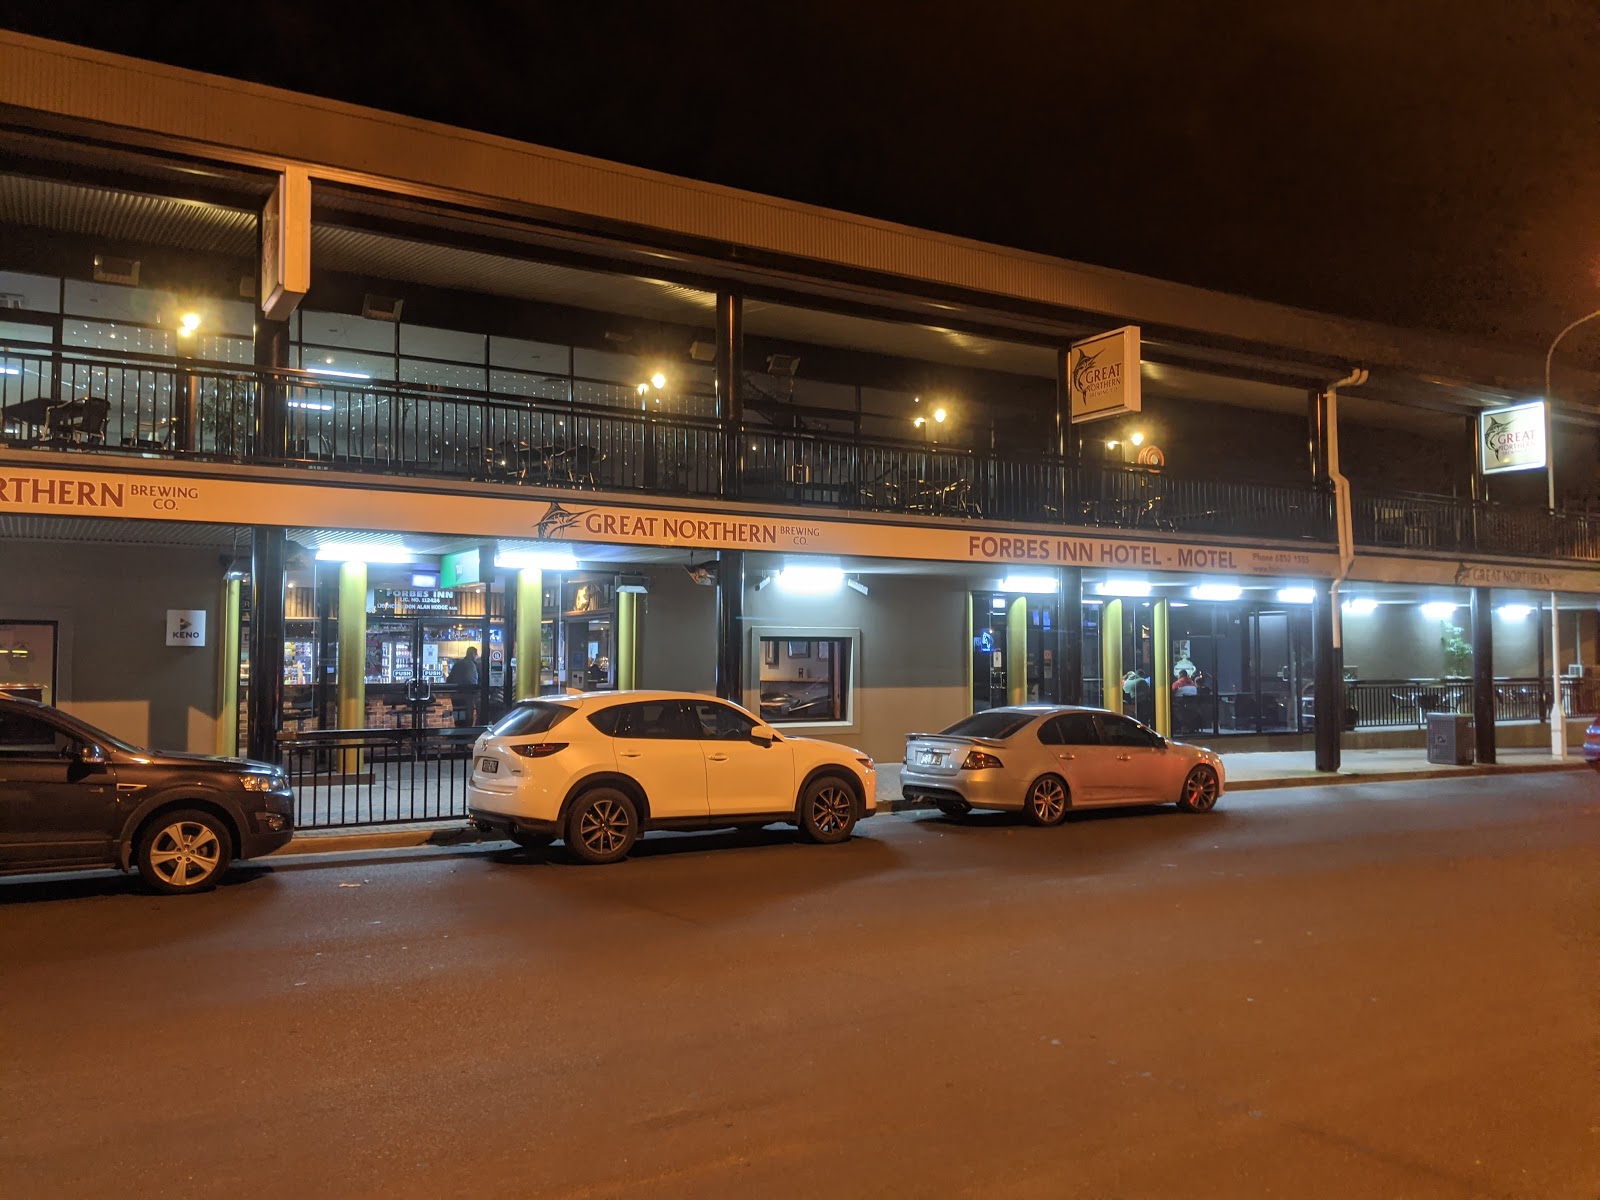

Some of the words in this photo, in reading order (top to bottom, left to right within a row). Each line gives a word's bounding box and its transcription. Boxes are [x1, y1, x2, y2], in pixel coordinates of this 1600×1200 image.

[1086, 363, 1122, 384] GREAT
[1087, 378, 1121, 392] NORTHERN
[1497, 430, 1536, 445] GREAT
[130, 484, 199, 499] BREWING
[152, 498, 179, 511] CO.
[585, 513, 658, 537] GREAT
[663, 518, 777, 544] NORTHERN
[780, 526, 820, 537] BREWING
[793, 536, 809, 546] CO.
[968, 536, 1050, 561] FORBES
[1056, 541, 1093, 562] INN
[1103, 543, 1162, 567] HOTEL
[1178, 548, 1237, 569] MOTEL
[1252, 552, 1273, 562] Phone
[1473, 568, 1500, 582] GREAT
[1503, 570, 1551, 585] NORTHERN
[386, 590, 429, 598] FORBES
[433, 591, 454, 599] INN
